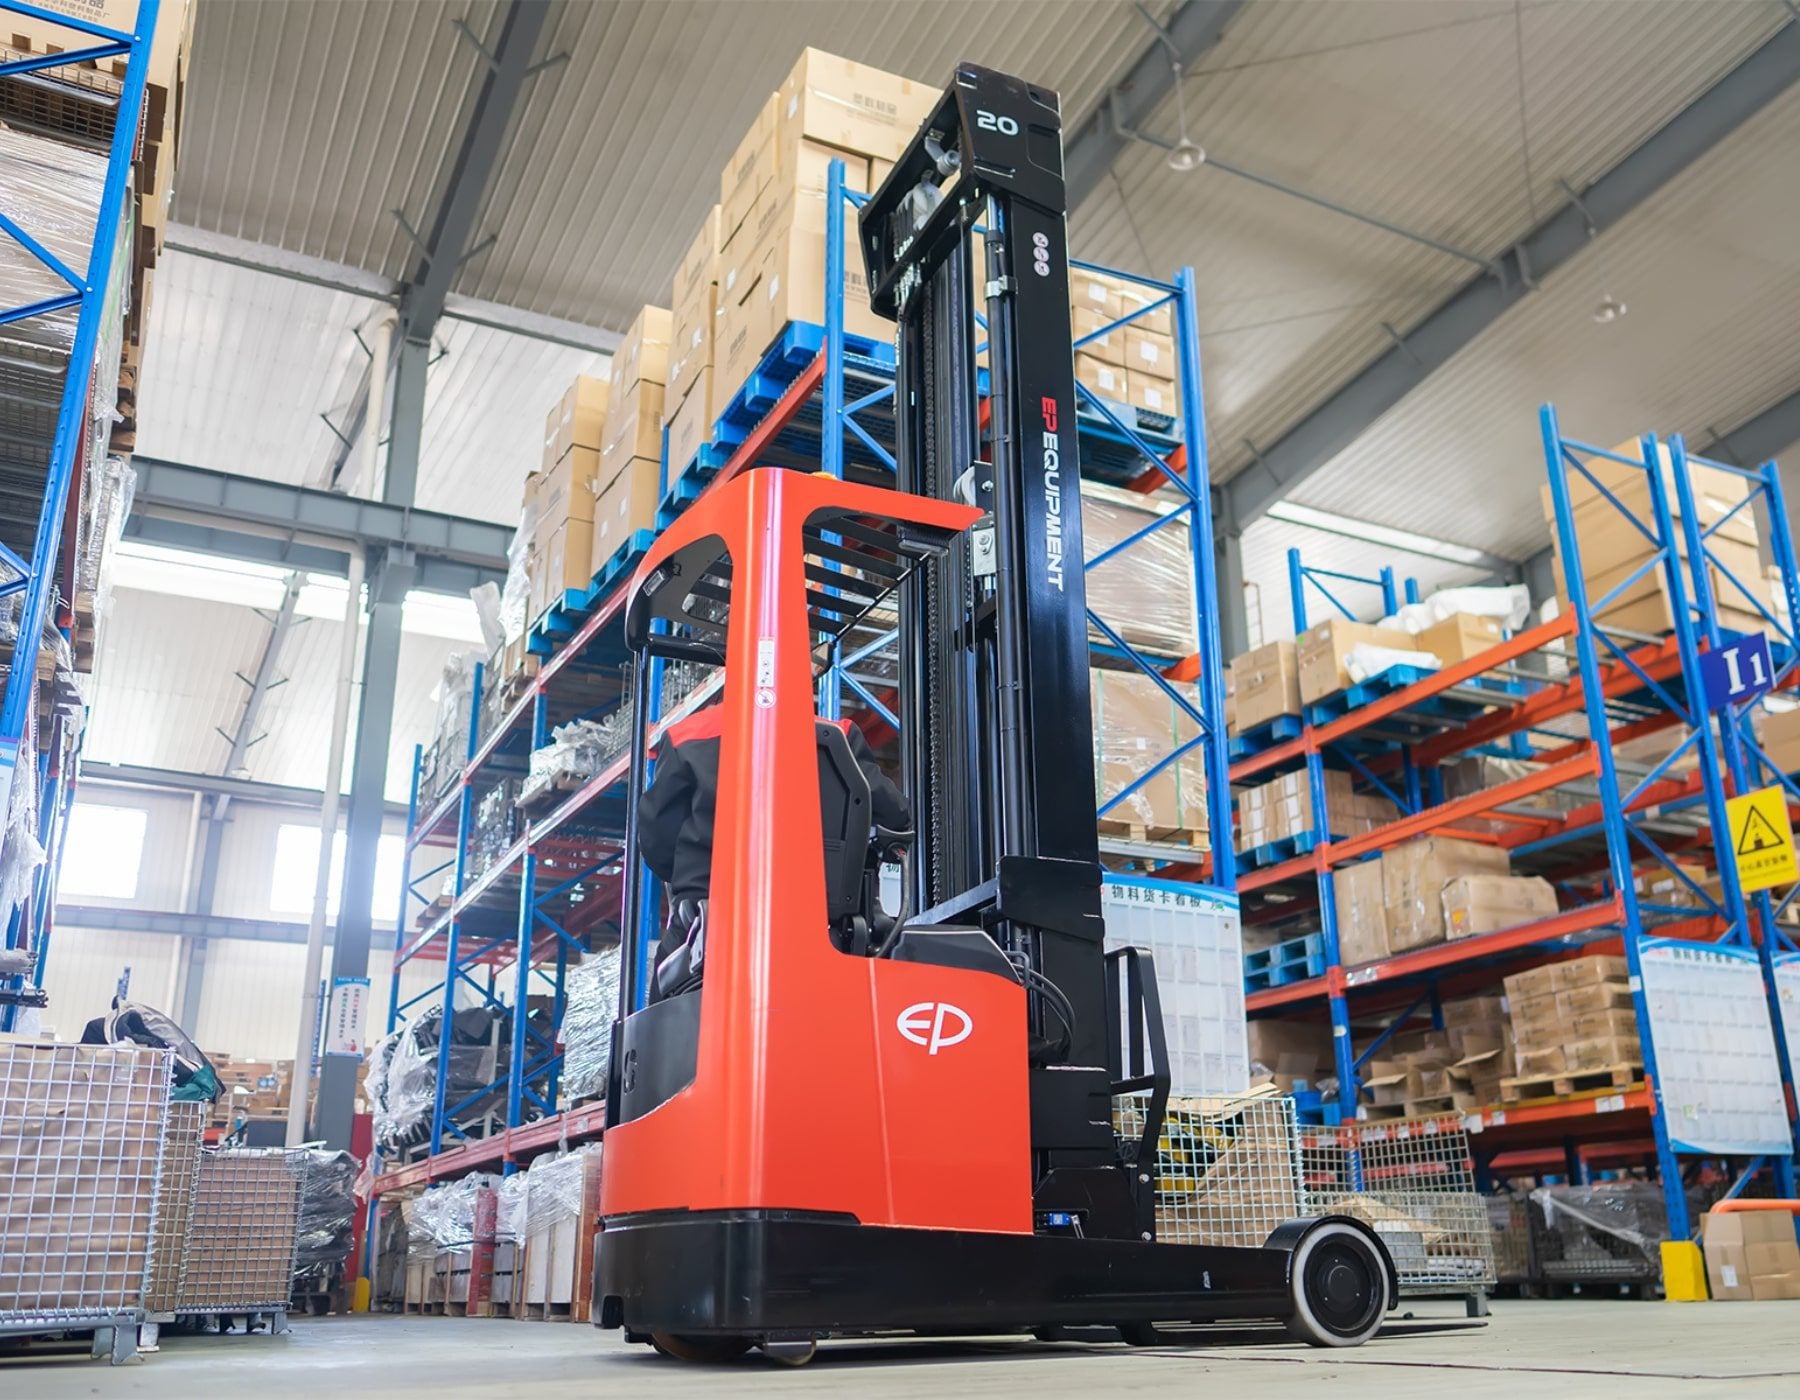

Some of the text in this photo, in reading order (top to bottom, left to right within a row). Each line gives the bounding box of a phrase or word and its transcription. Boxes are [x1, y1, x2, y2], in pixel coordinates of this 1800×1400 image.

[976, 109, 1019, 136] 20
[1041, 396, 1064, 593] EP EQUIPMENT
[896, 1001, 974, 1056] EP
